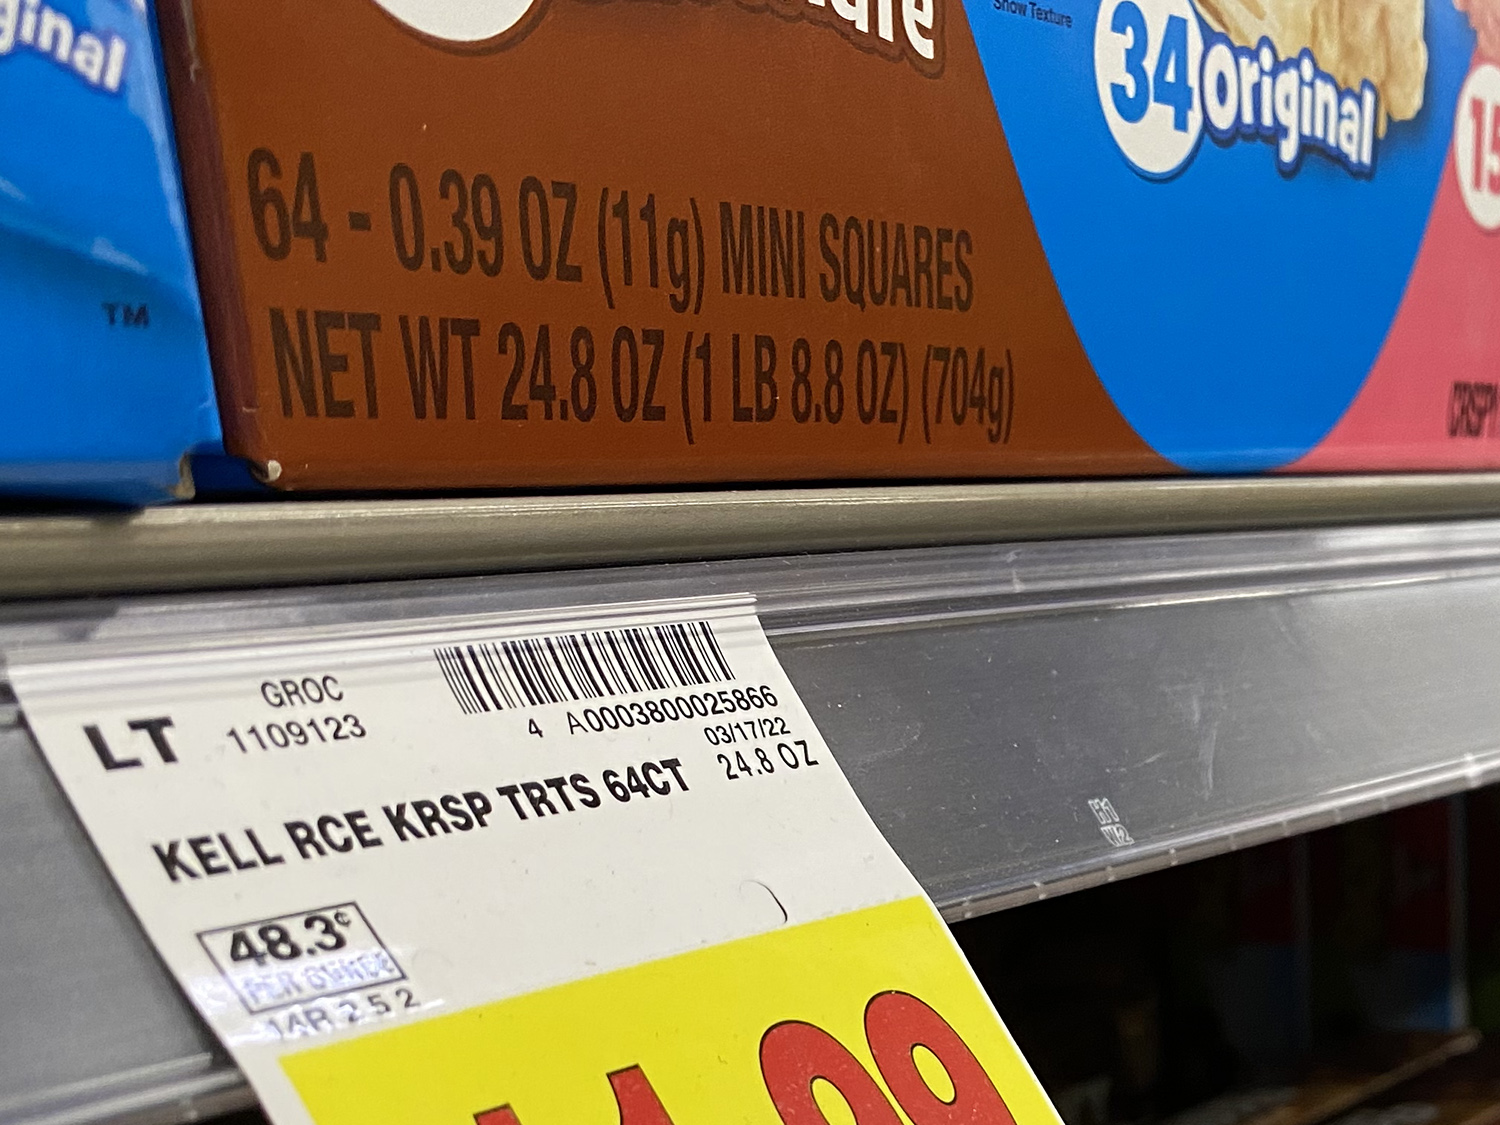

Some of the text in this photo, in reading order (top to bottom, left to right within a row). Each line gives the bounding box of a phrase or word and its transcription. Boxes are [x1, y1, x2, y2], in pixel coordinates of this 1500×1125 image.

[1030, 2, 1073, 29] Texture
[0, 0, 127, 93] ginal
[1110, 0, 1376, 165] 34 Original
[247, 148, 328, 263] 64
[389, 163, 503, 277] 0.39
[518, 176, 582, 283] OZ
[597, 187, 703, 314] (11g)
[719, 201, 806, 300] MINI
[819, 213, 974, 311] SQUARES
[269, 308, 1014, 445] NET WT 24.8 OZ (1 LB 8.8 OZ) (704g)
[261, 675, 344, 708] GROC
[528, 685, 778, 738] 4 A0003800025866
[83, 714, 367, 770] LT 1109123
[704, 717, 791, 746] 03/17/22
[717, 740, 819, 781] 24.8 OZ
[152, 758, 690, 882] KELL RCE KRSP TRTS 64CT
